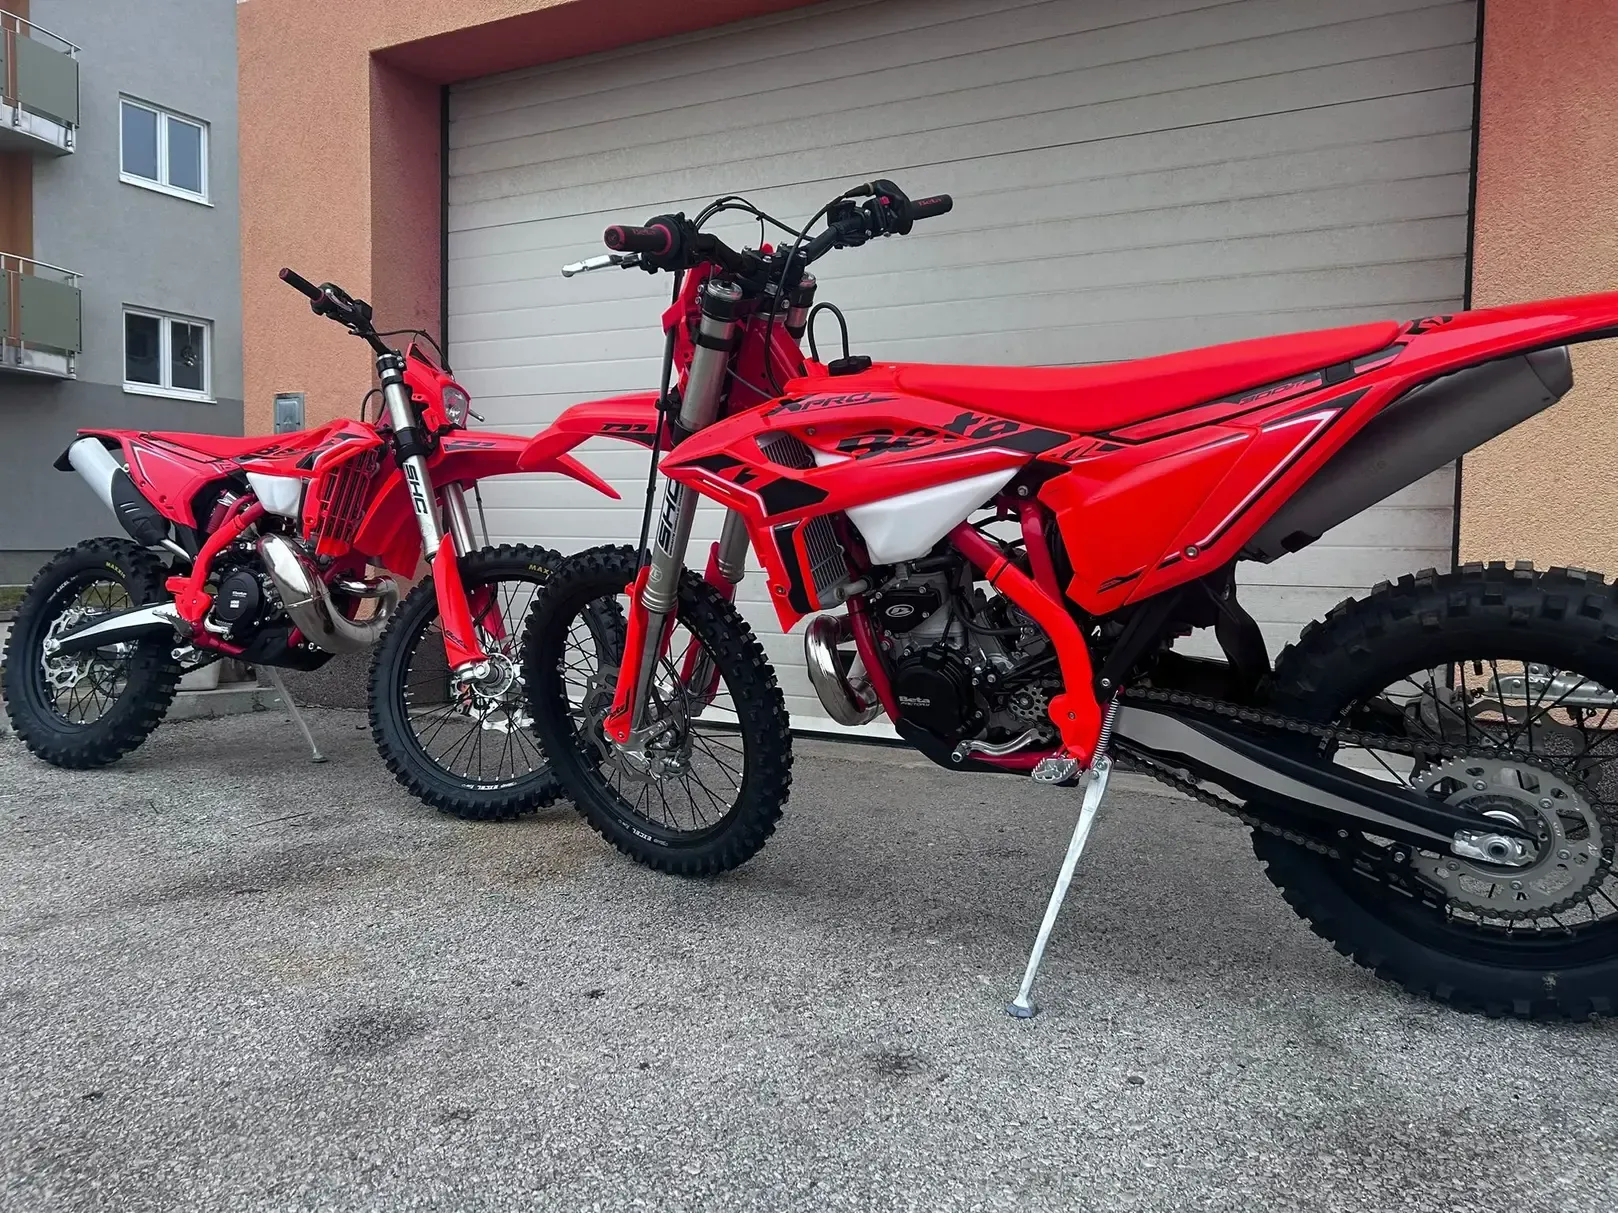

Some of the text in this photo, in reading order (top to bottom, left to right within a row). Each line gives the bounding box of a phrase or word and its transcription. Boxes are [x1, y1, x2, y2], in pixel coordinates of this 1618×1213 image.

[405, 464, 428, 514] SHC
[105, 561, 126, 579] MAXXIS
[899, 696, 930, 704] Beta
[632, 827, 652, 842] EXCEL
